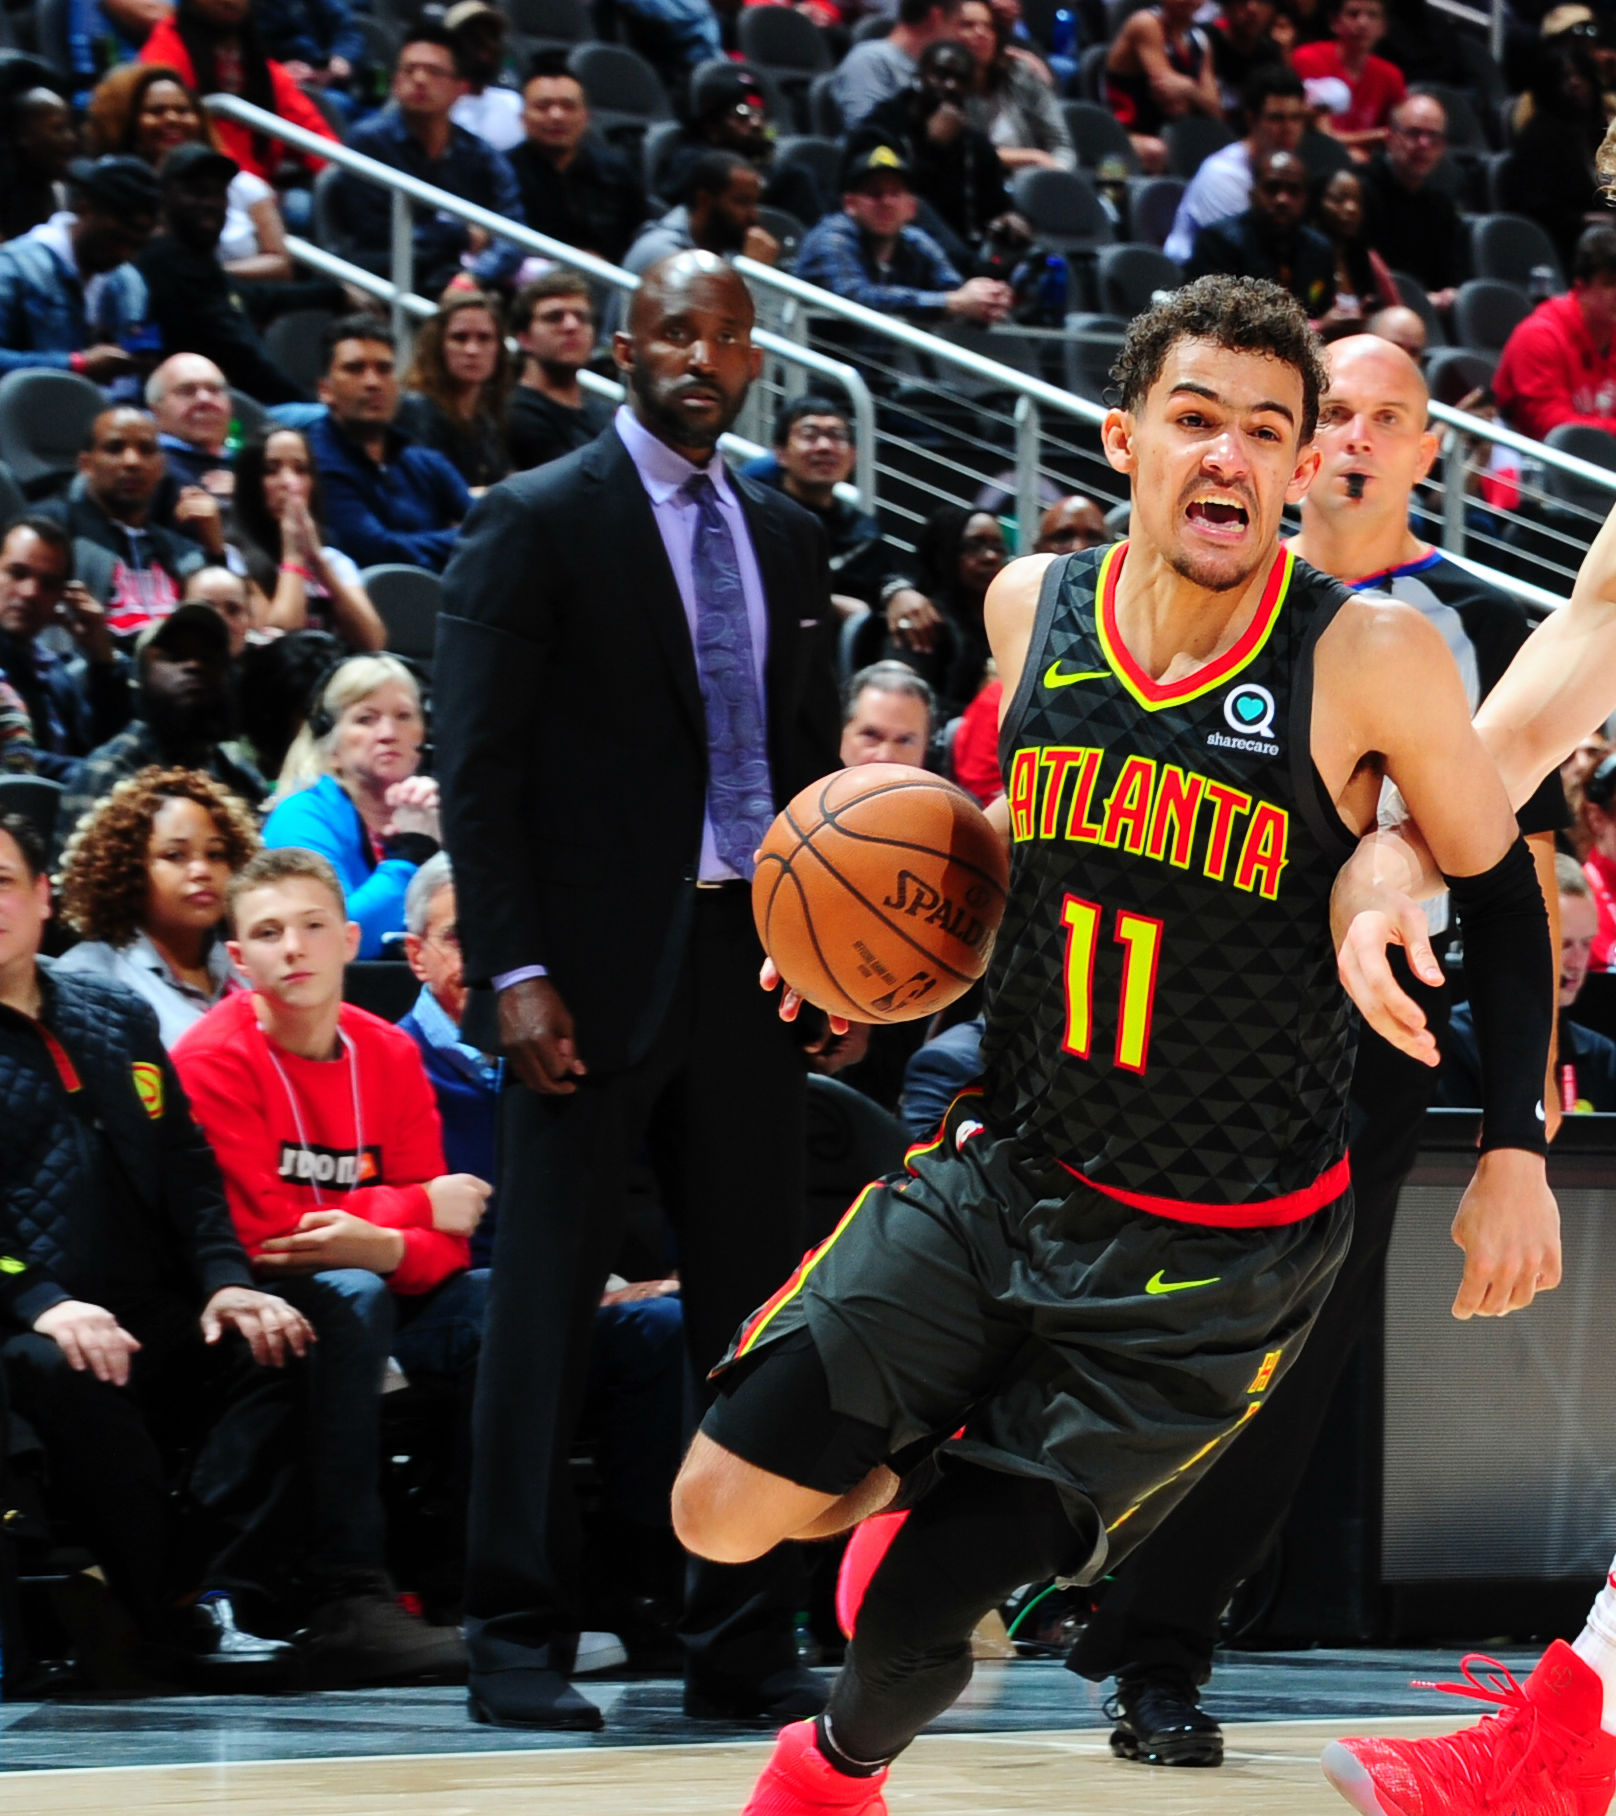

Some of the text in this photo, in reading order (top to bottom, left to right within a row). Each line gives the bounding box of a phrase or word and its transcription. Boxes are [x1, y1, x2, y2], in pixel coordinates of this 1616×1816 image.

[1206, 731, 1280, 756] sharecare
[1008, 746, 1290, 901] ATLANTA
[1059, 892, 1164, 1075] 11
